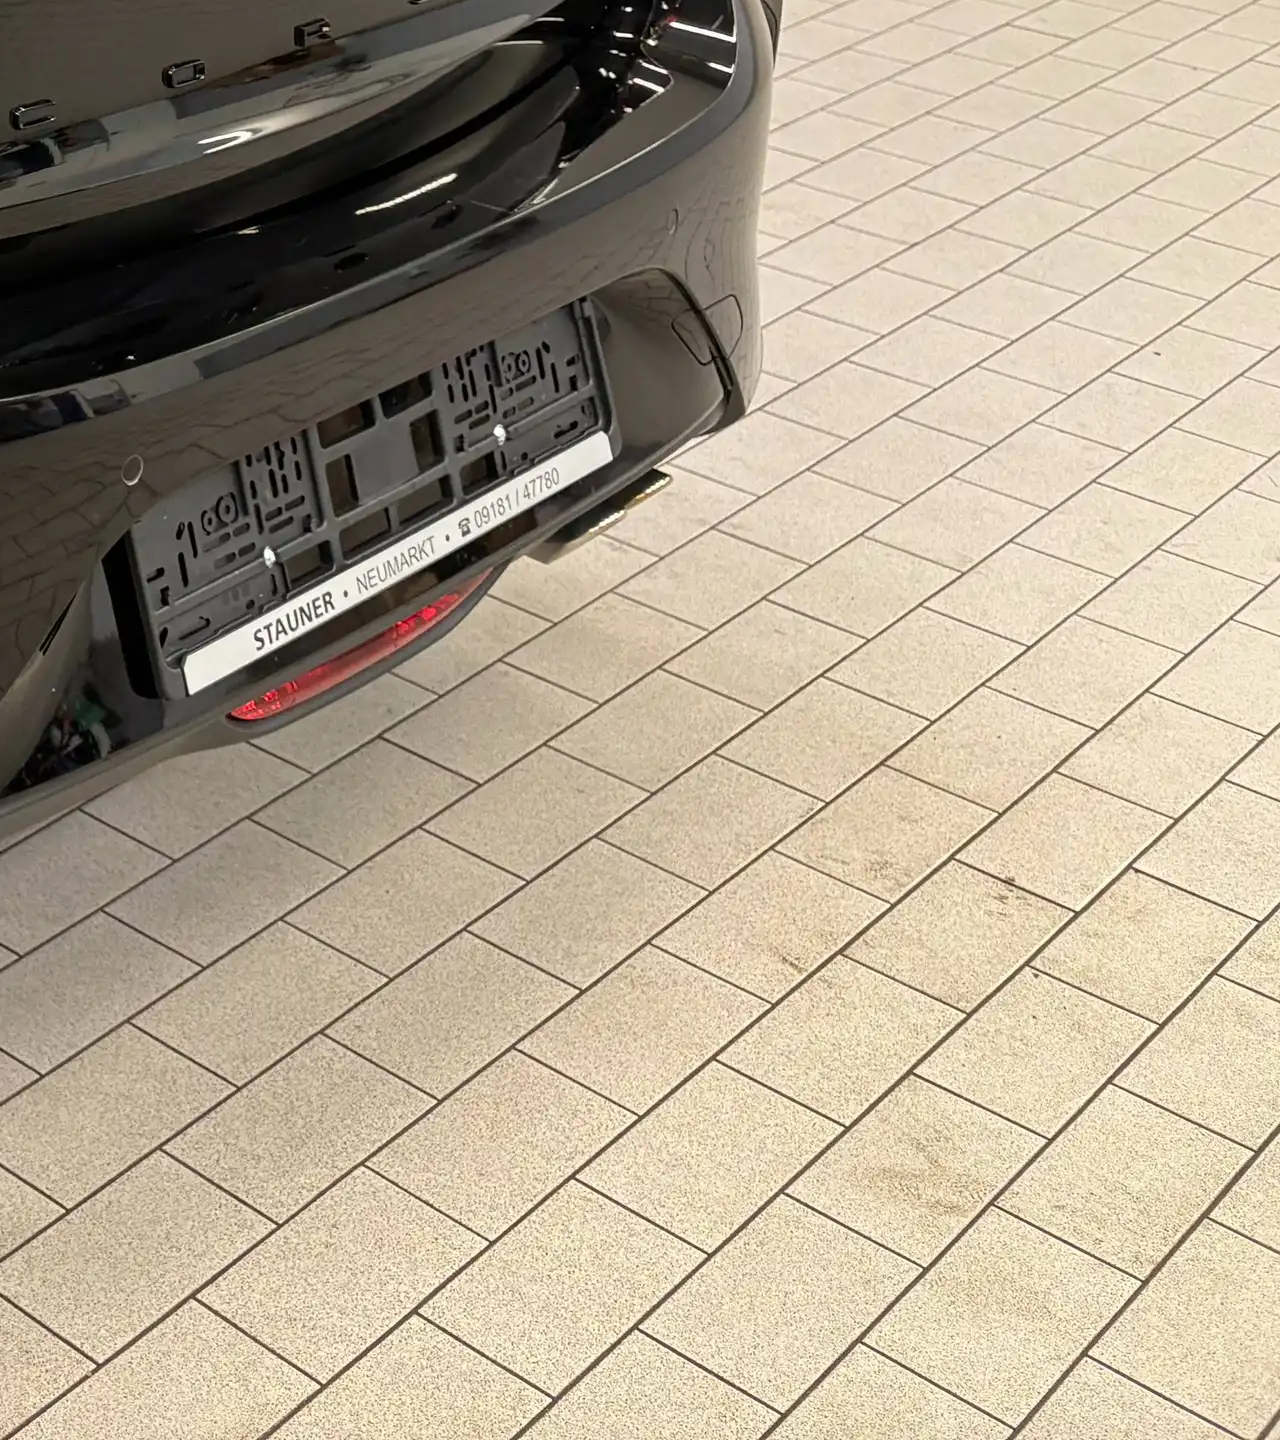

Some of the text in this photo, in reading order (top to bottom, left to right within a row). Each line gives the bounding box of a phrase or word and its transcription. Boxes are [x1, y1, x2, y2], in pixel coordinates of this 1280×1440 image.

[253, 591, 336, 652] STAUNER
[355, 535, 436, 595] NEUMARKT
[473, 494, 513, 529] 09181
[523, 467, 560, 501] 47780
